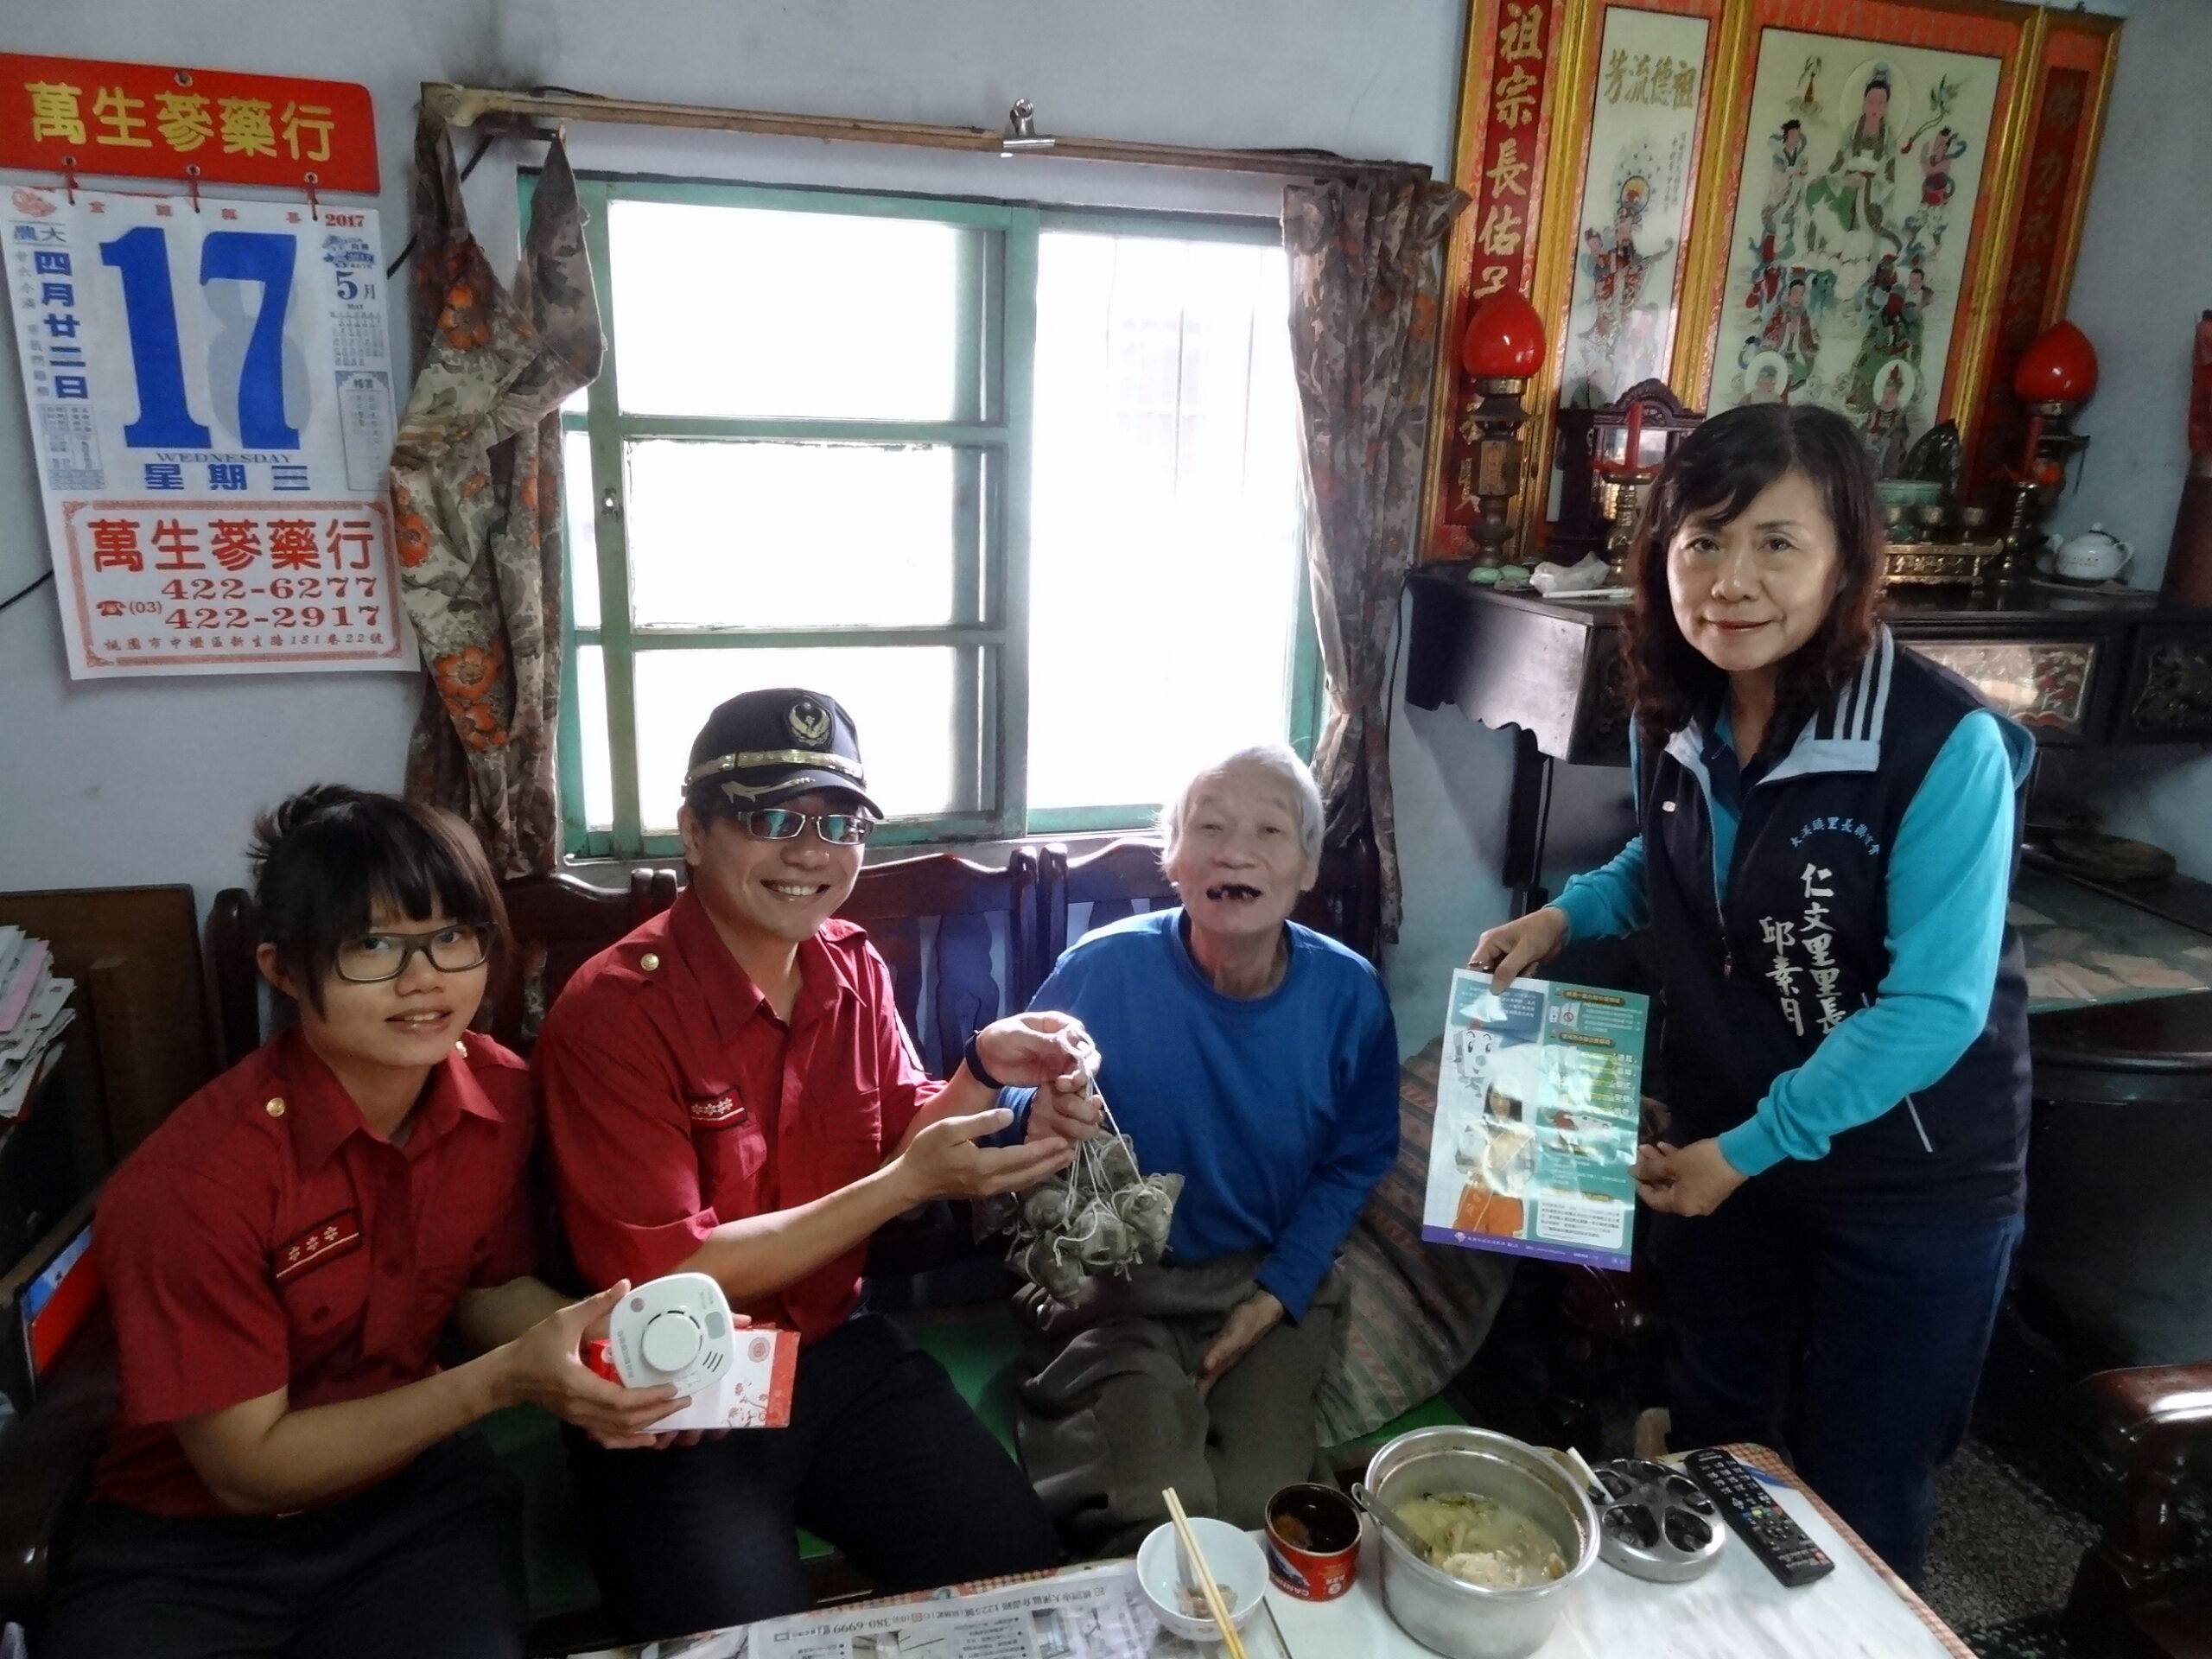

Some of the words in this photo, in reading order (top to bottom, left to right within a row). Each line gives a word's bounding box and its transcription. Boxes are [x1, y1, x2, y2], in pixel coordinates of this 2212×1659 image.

[24, 81, 334, 162] 萬生蔘藥行
[325, 213, 365, 227] 2017
[34, 251, 88, 399] 四月廿二日
[99, 226, 300, 449] 17
[144, 463, 310, 491] 星期三
[156, 453, 293, 464] WEDNESDAY
[88, 518, 374, 573] 萬生蔘藥行
[161, 576, 377, 601] 422-6277
[130, 601, 162, 615] (03)
[165, 606, 380, 629] 422-2917
[1799, 863, 1847, 1034] 仁文里里長
[1758, 916, 1804, 1037] 邱素月
[833, 1617, 892, 1634] 380-6999
